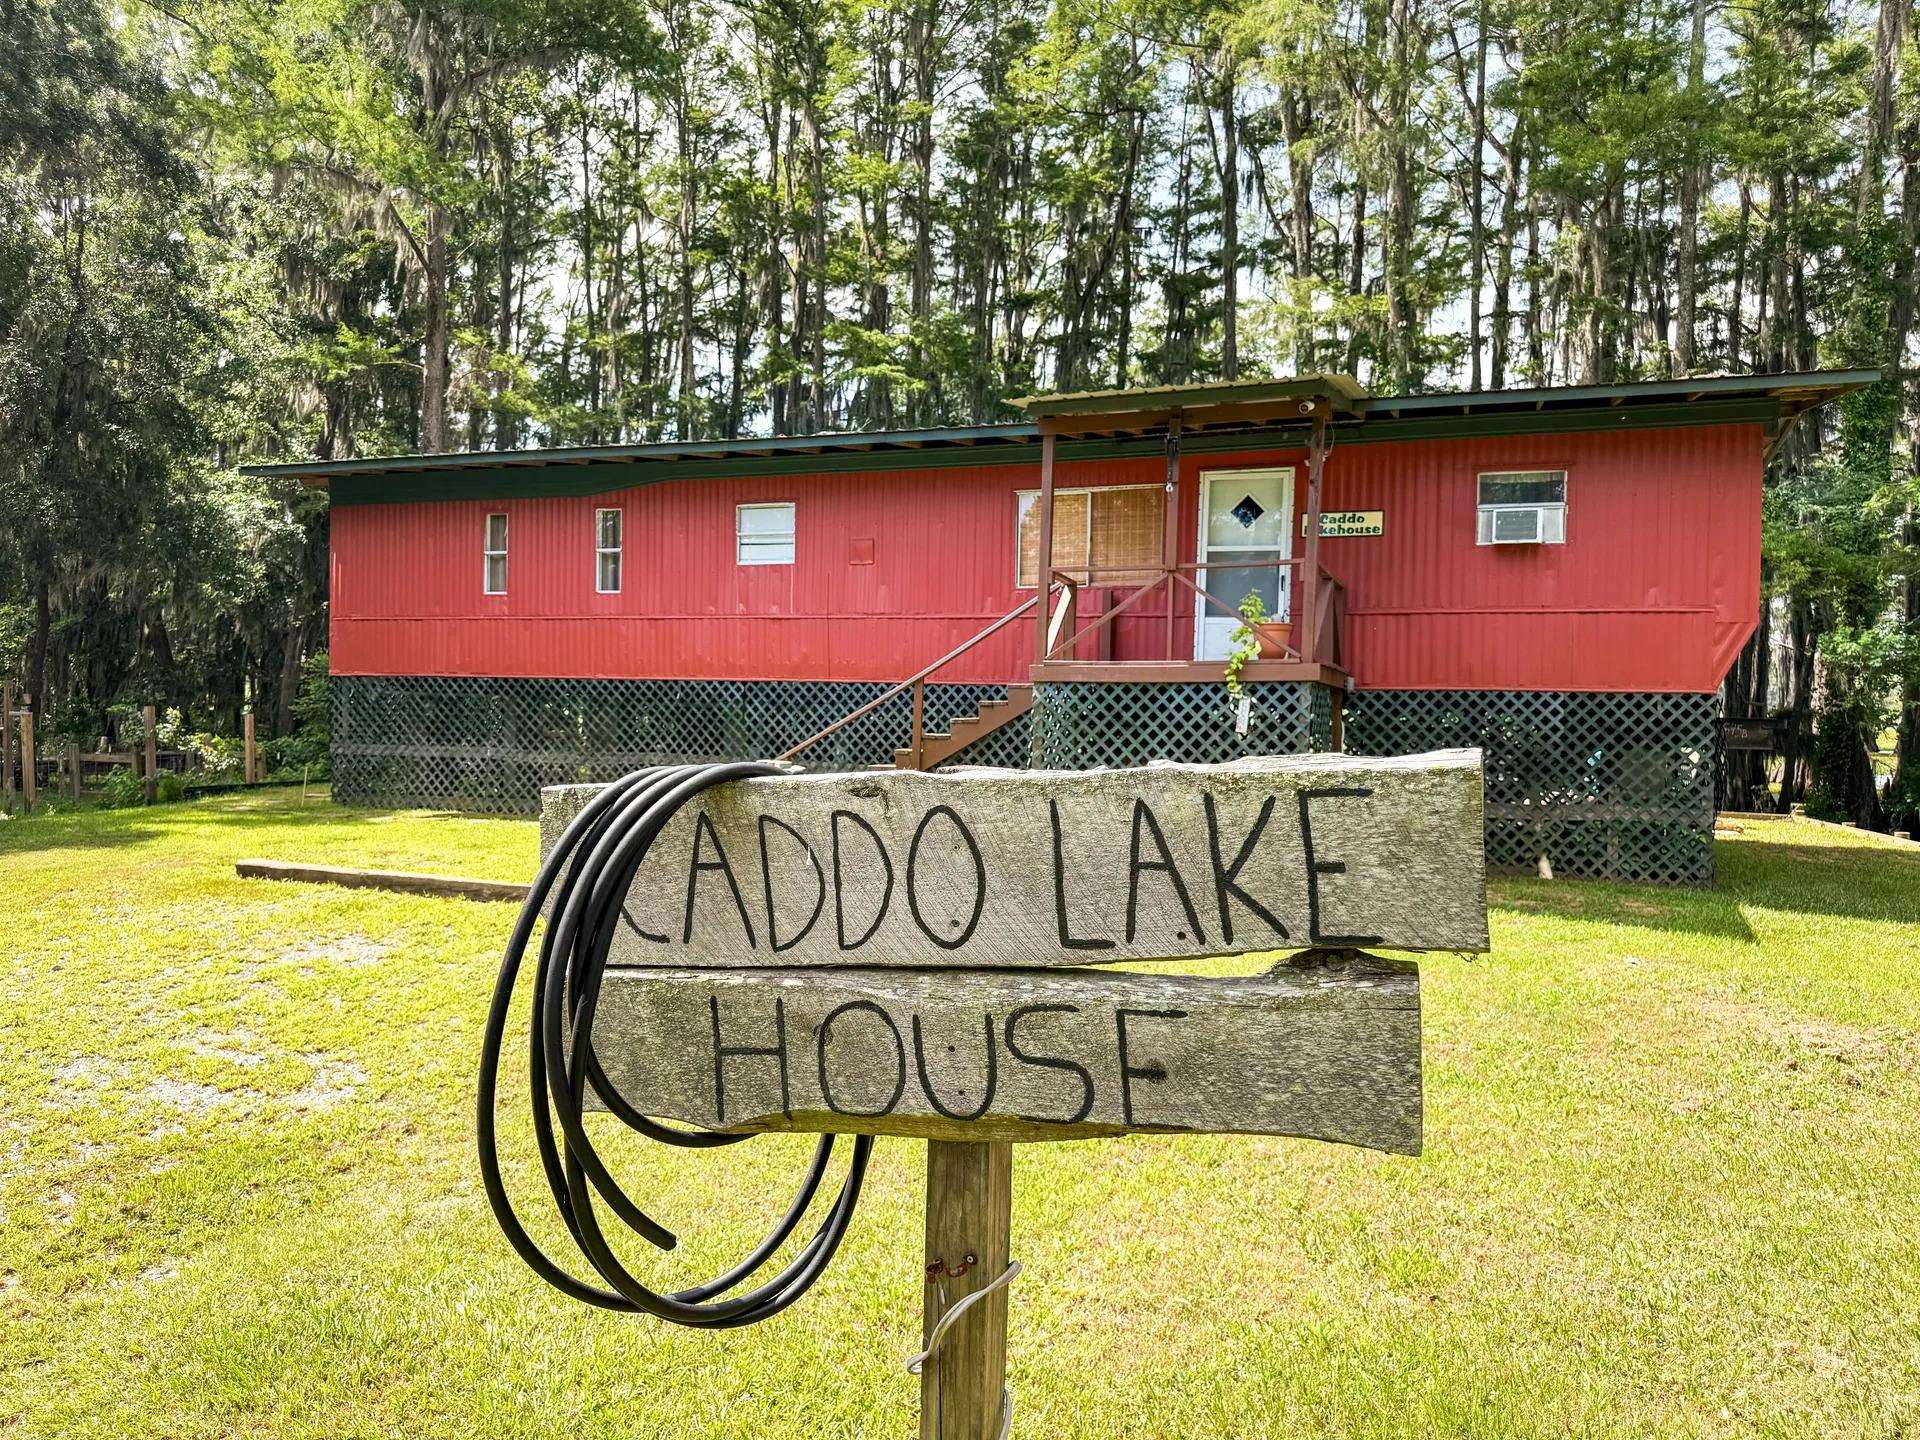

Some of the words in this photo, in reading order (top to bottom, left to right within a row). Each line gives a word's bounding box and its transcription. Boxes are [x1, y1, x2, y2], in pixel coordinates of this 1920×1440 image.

[1304, 525, 1380, 535] kehouse
[1320, 513, 1365, 524] Caddo
[1050, 789, 1383, 949] LAKE
[709, 996, 1190, 1130] HOUSE
